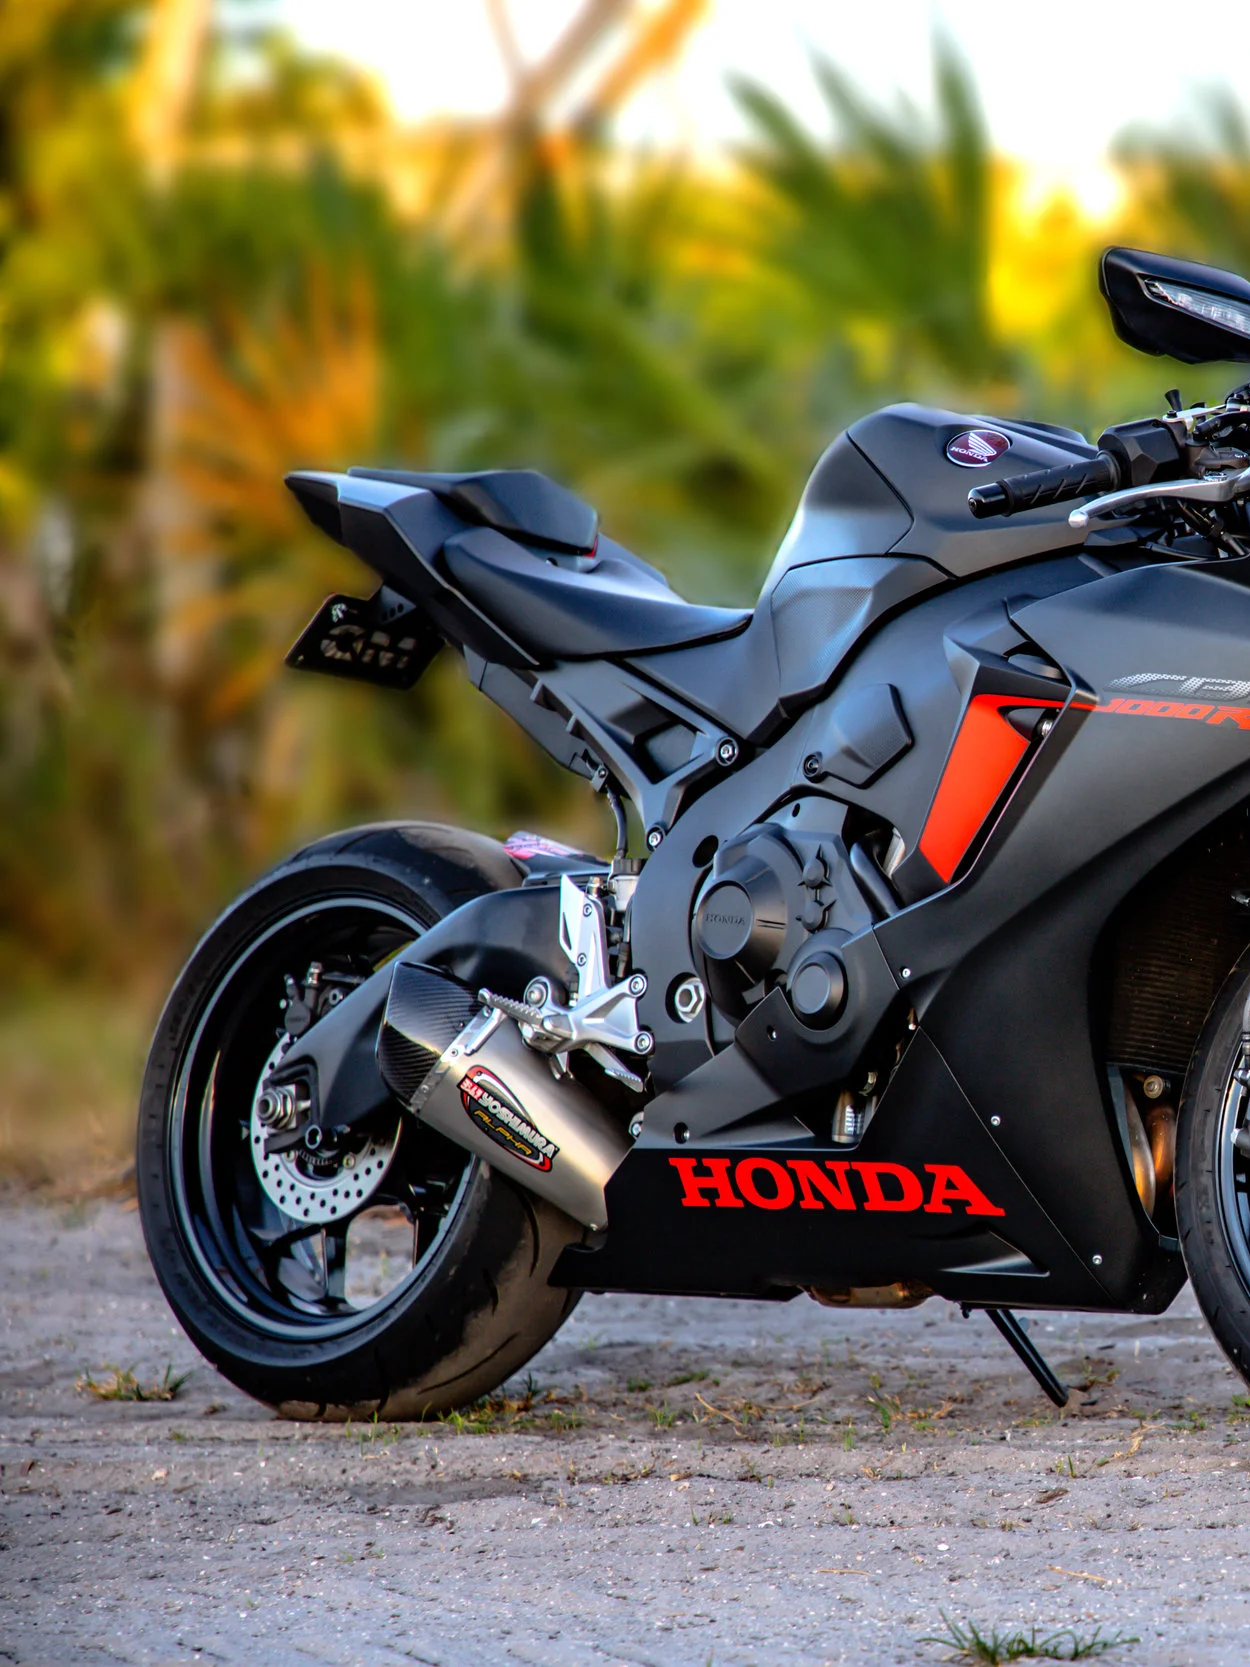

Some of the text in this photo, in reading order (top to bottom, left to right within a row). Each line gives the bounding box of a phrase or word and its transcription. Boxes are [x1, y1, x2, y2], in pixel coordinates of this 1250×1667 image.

[950, 446, 988, 462] HONDA
[705, 912, 746, 926] HONDA
[473, 1109, 533, 1156] ALPHA
[479, 1092, 556, 1157] YOSHIMURA
[668, 1157, 1006, 1216] HONDA
